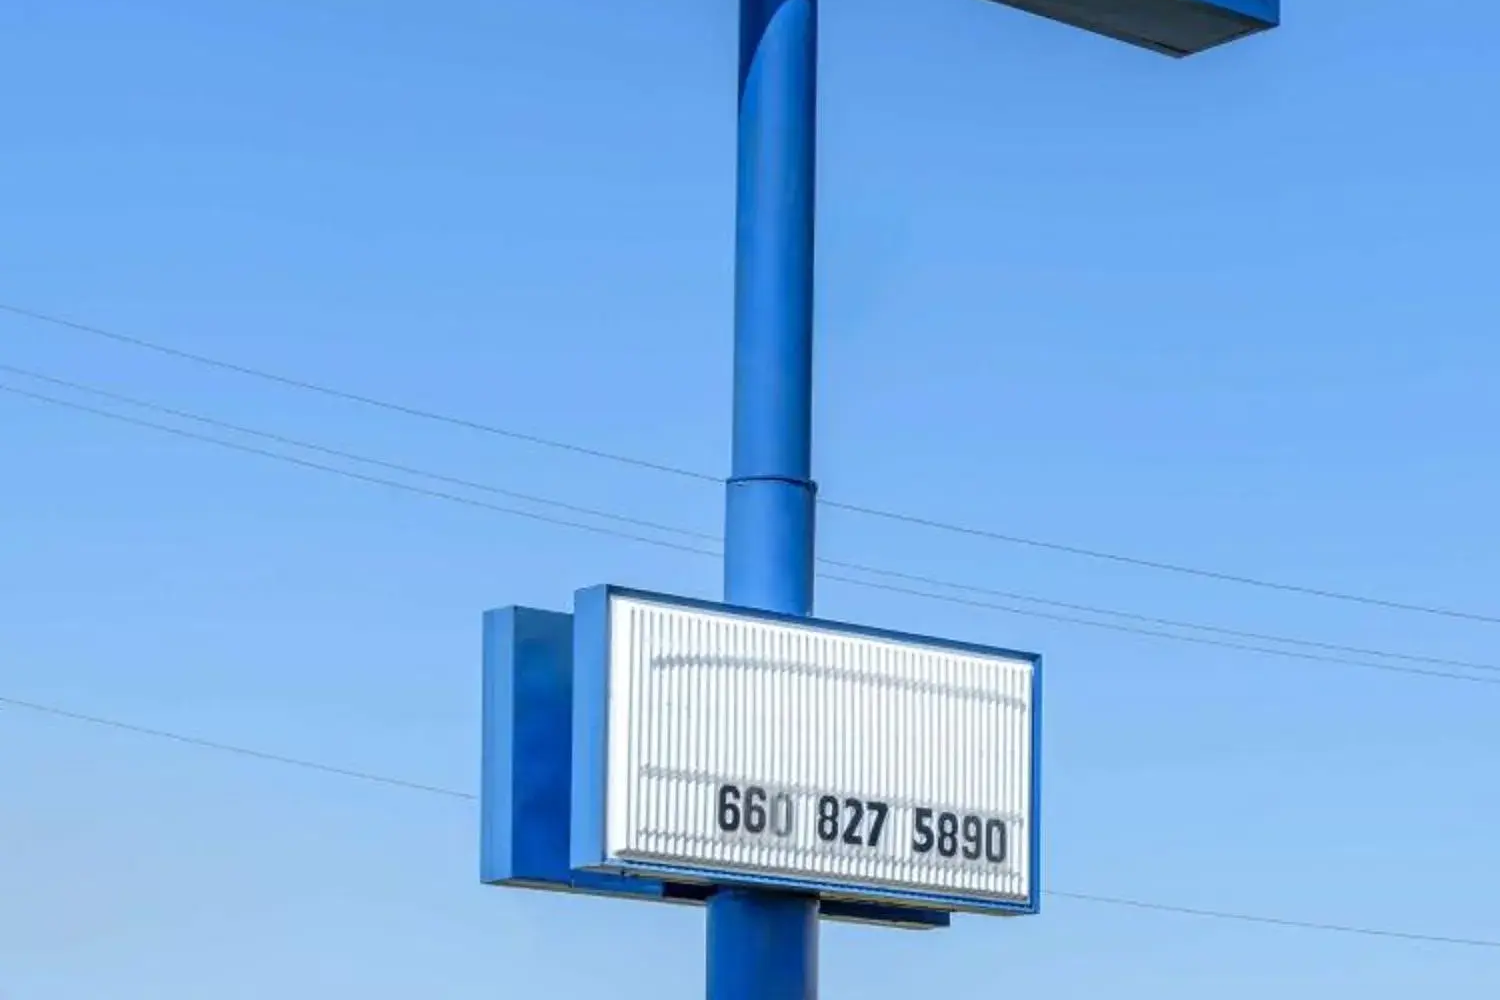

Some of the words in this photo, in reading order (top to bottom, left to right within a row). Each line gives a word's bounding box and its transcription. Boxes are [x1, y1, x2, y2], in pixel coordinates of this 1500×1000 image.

[717, 784, 794, 839] 660
[816, 794, 889, 848] 827
[911, 806, 1008, 864] 5890
